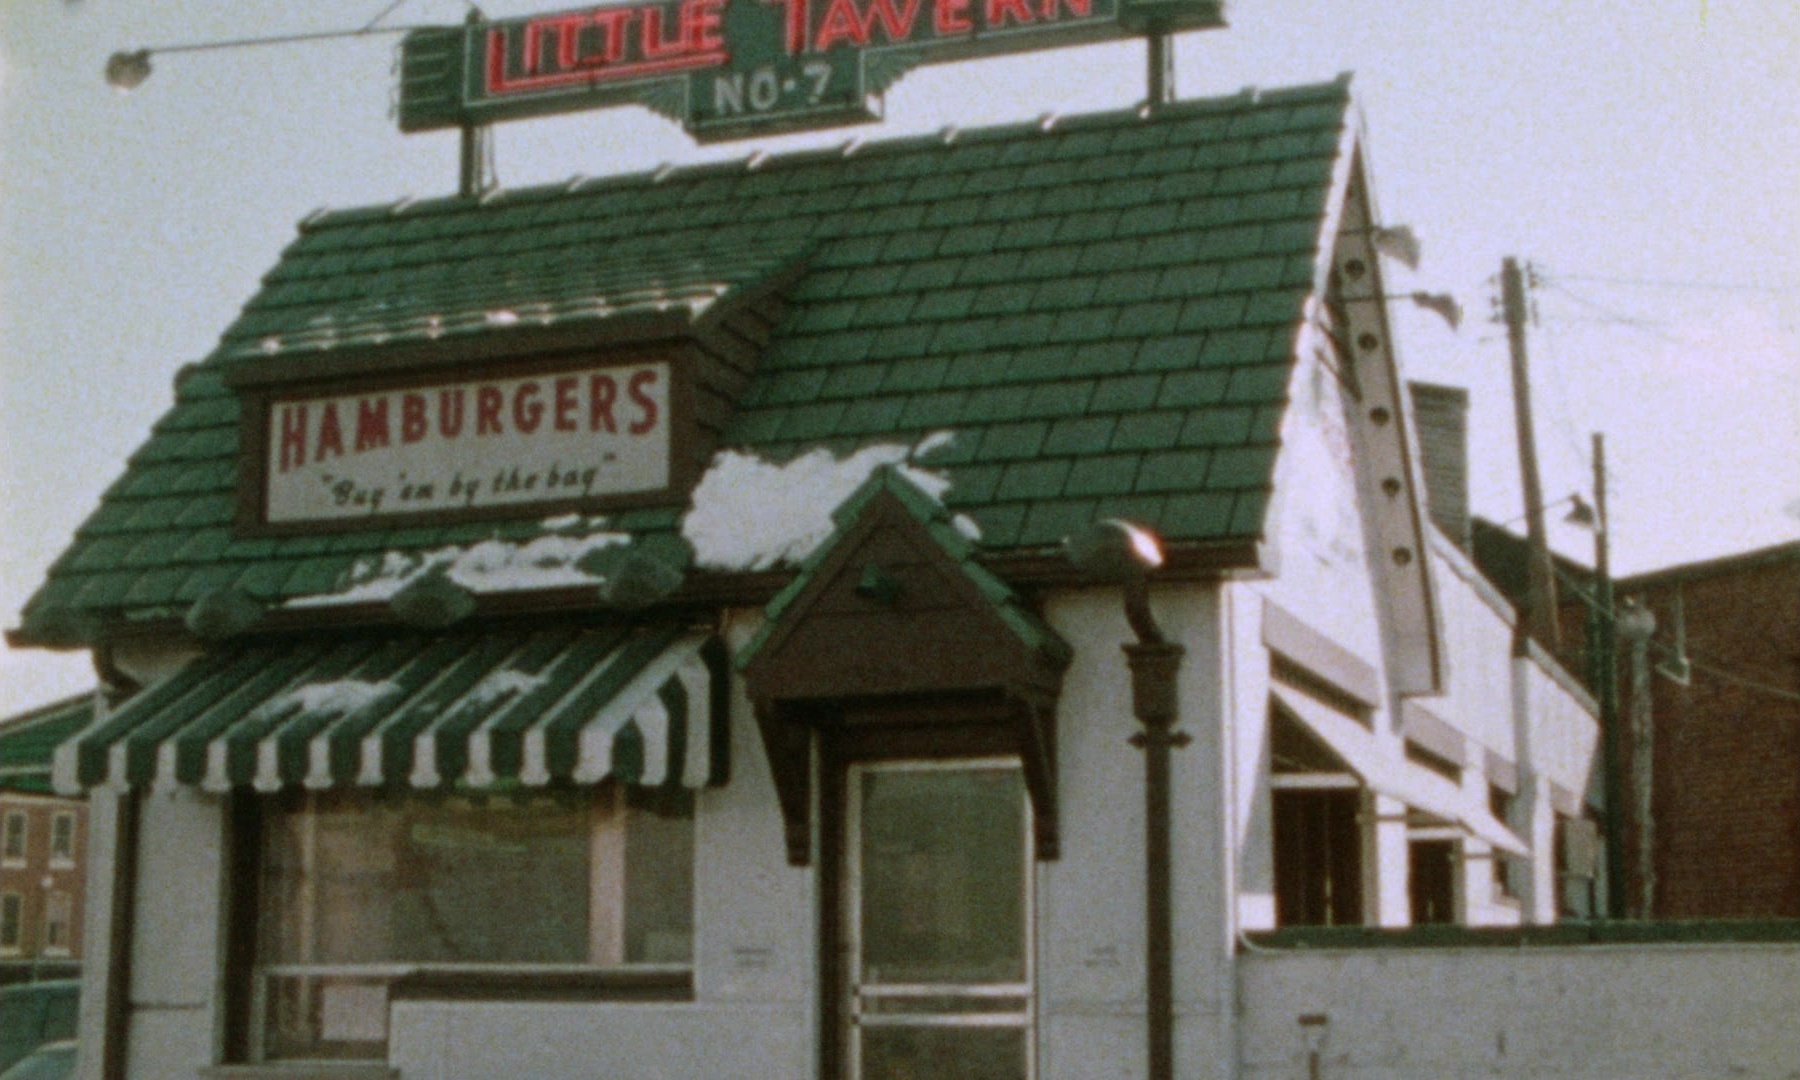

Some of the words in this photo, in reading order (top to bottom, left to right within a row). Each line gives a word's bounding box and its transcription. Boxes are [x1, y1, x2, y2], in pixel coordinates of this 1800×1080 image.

[486, 0, 731, 94] LITTLE
[279, 368, 659, 474] HAMBURGERS
[449, 471, 480, 507] by
[493, 465, 539, 495] the
